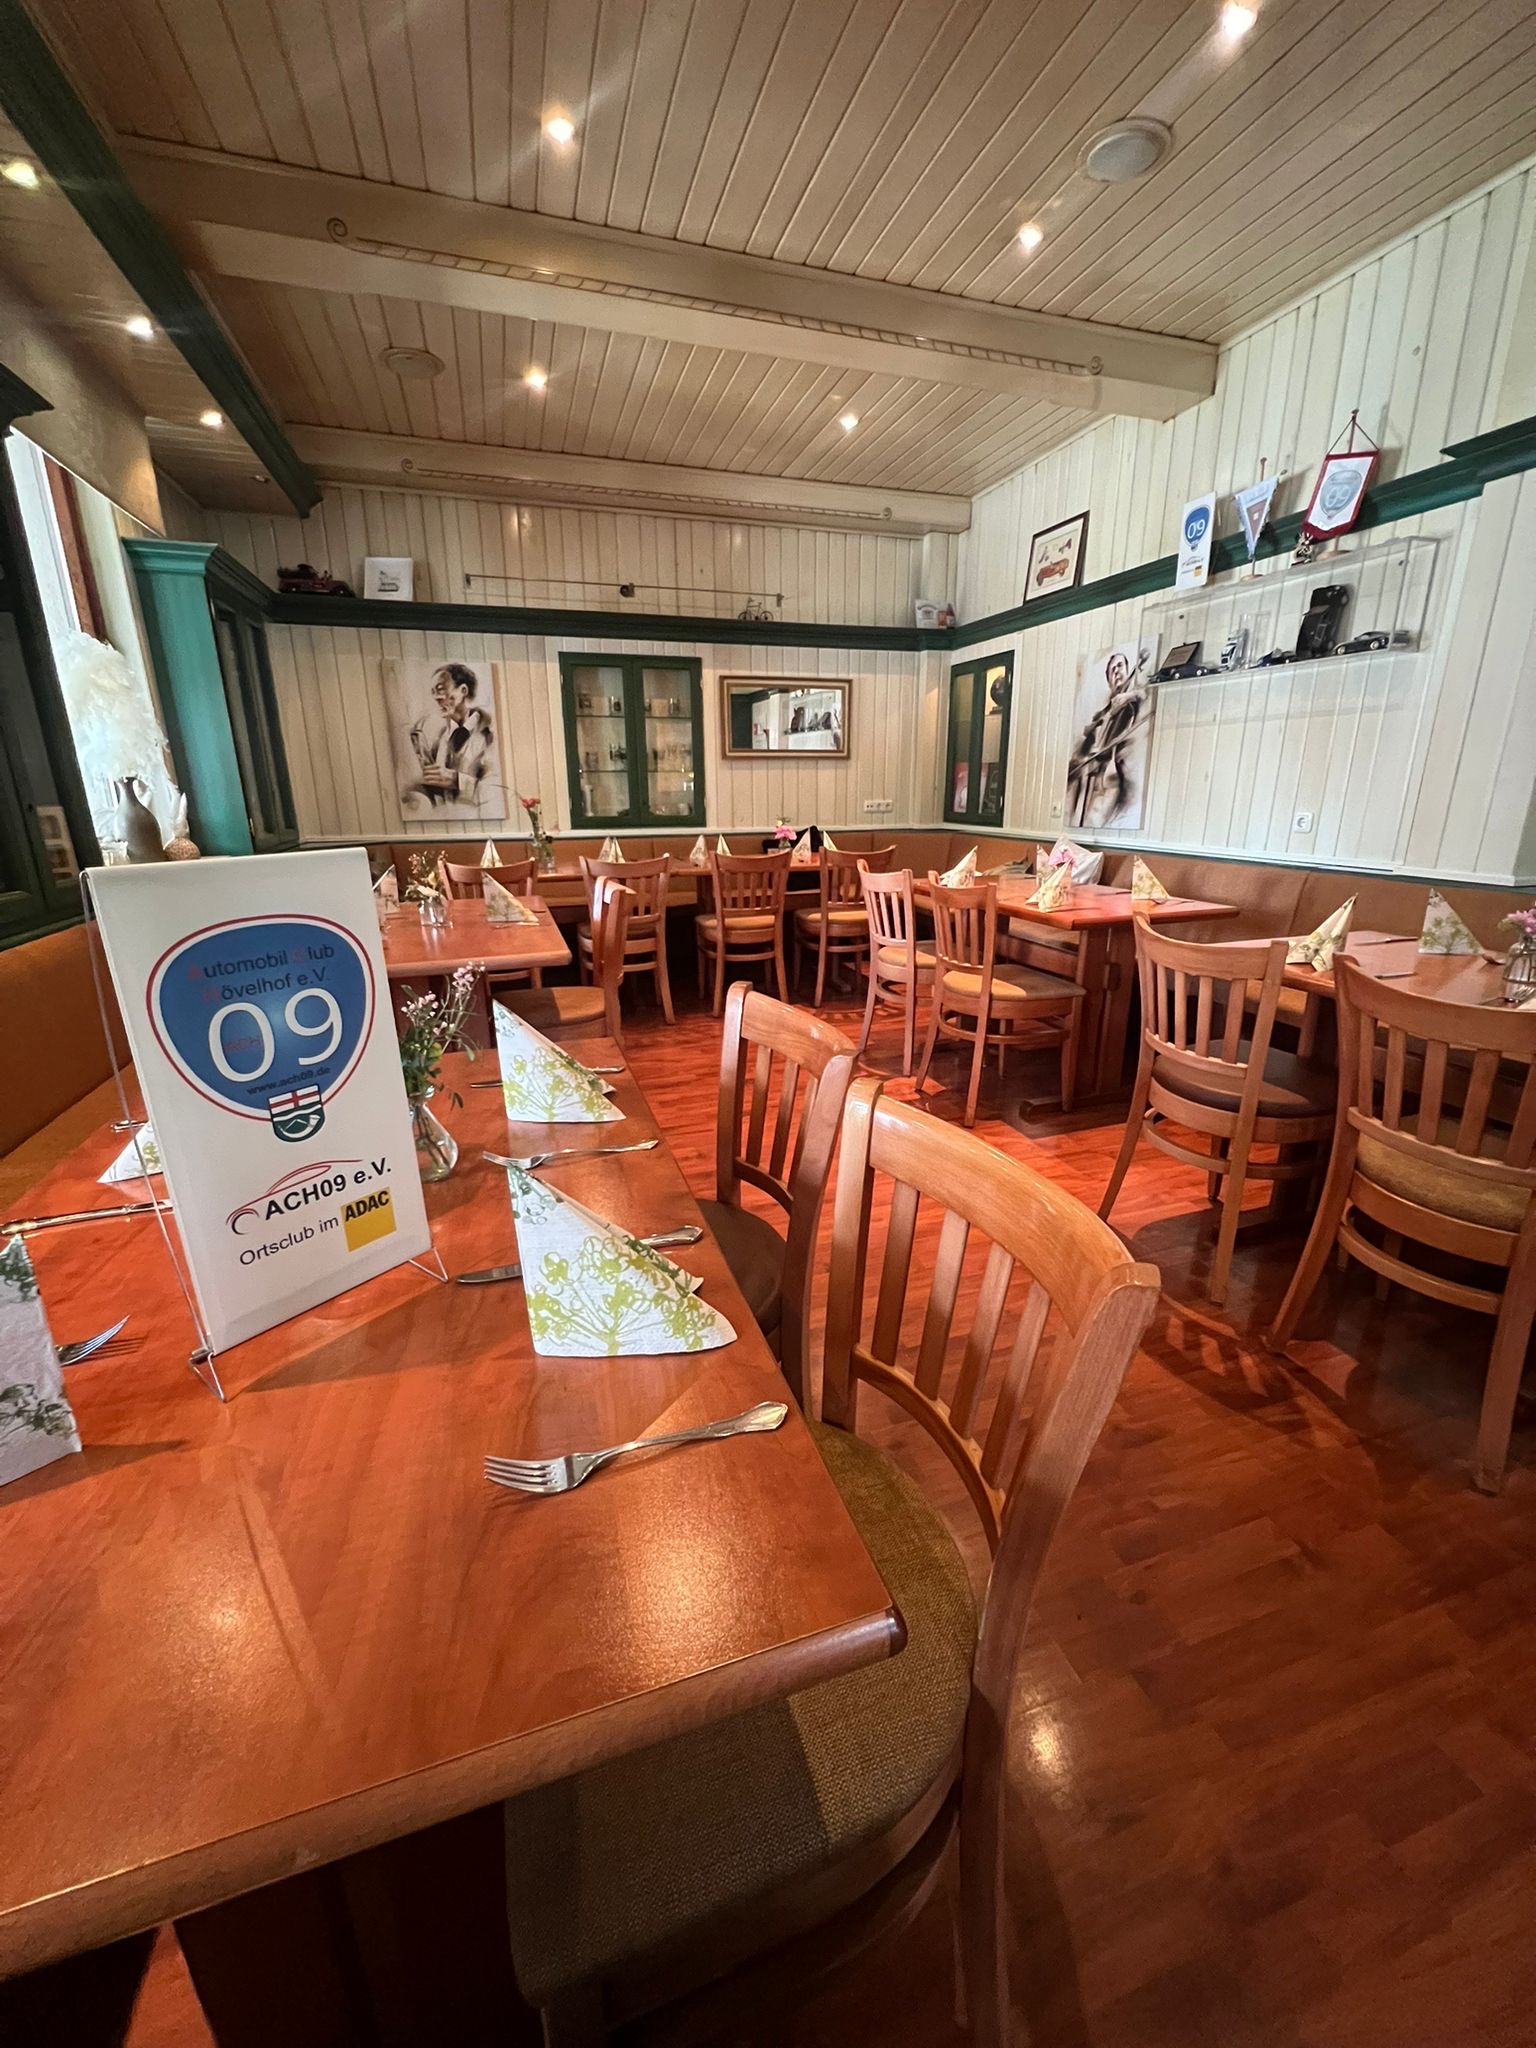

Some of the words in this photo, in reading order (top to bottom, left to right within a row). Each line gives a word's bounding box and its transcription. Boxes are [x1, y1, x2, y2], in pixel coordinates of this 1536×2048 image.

[1187, 519, 1206, 539] 09
[187, 950, 289, 980] Automobil
[208, 987, 343, 1082] 09
[246, 1066, 331, 1095] www.ach09.de
[265, 1174, 347, 1220] ACH09
[353, 1157, 392, 1184] e.V.
[239, 1226, 315, 1265] Ortsclub
[319, 1216, 339, 1233] im
[345, 1190, 390, 1222] ADAC
